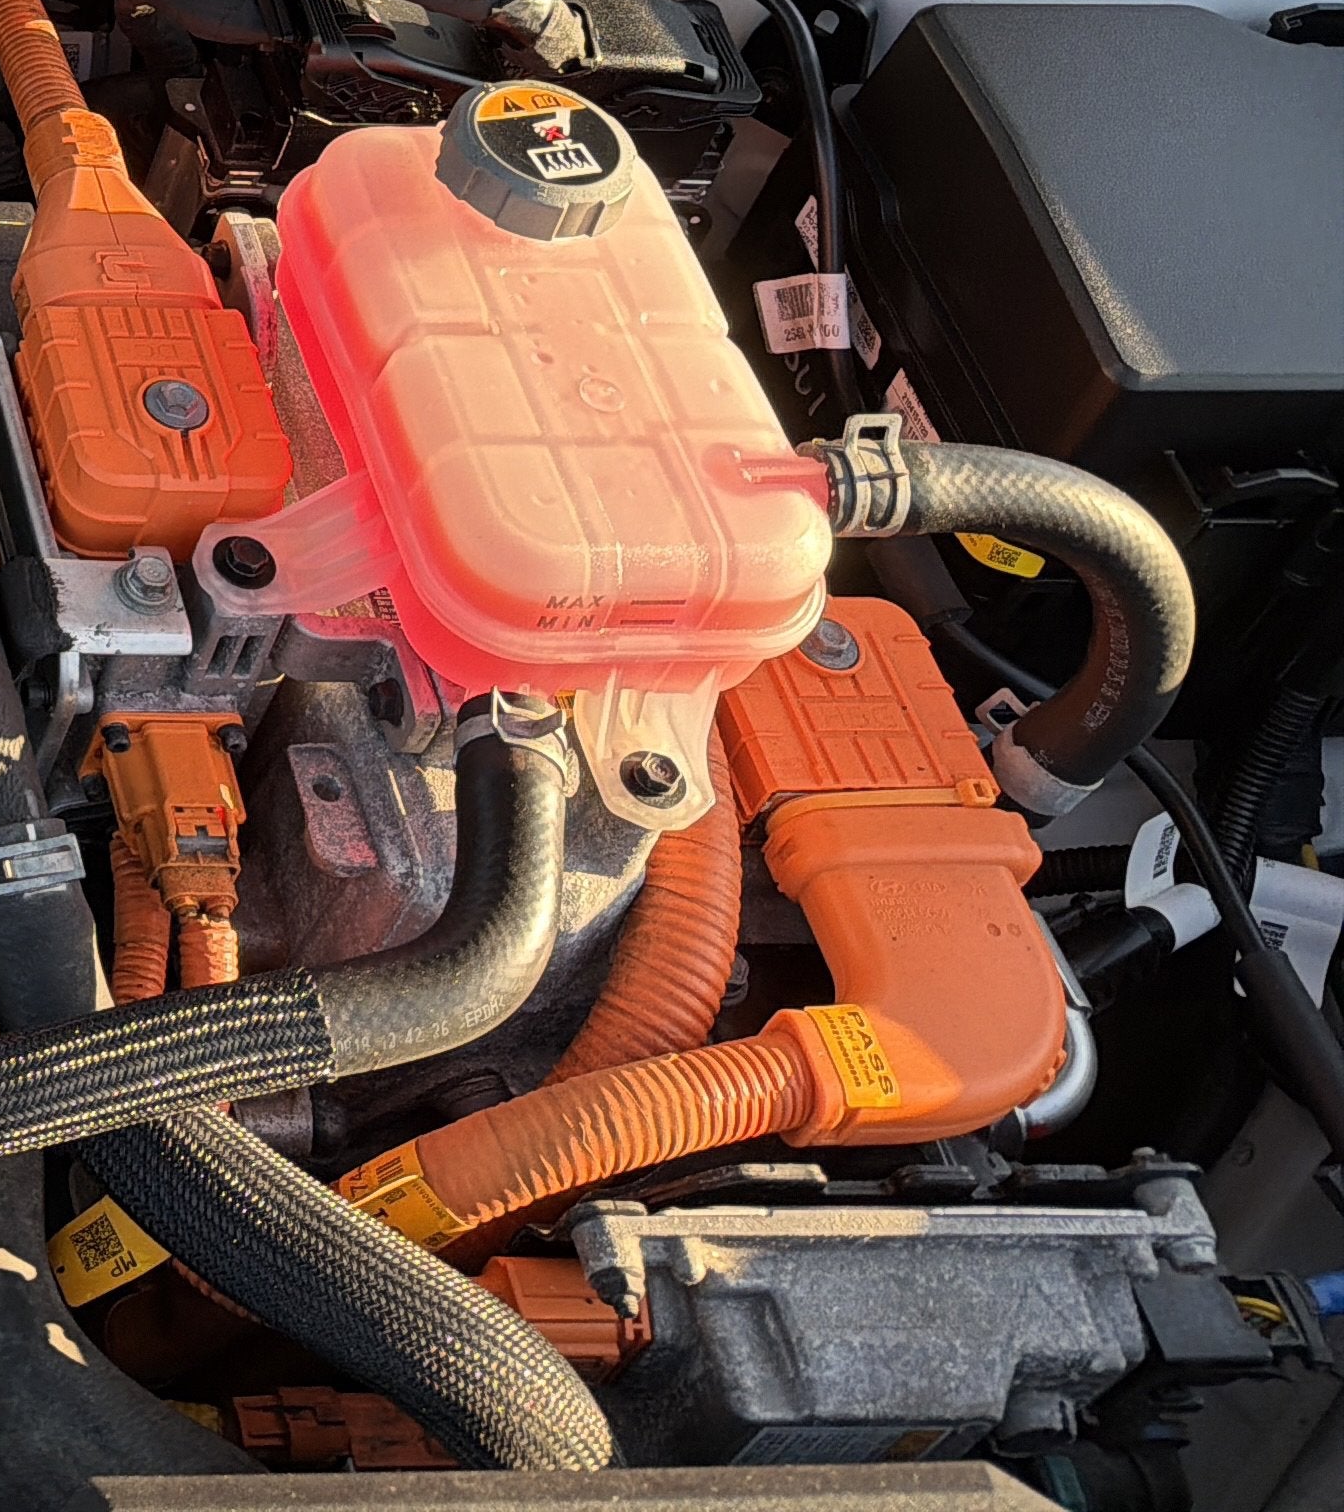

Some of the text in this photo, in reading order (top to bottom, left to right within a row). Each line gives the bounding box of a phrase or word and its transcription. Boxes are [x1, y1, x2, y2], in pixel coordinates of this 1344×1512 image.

[545, 595, 606, 610] MAX
[535, 614, 597, 630] MIN
[847, 1011, 894, 1096] PASS
[111, 1250, 138, 1278] MP
